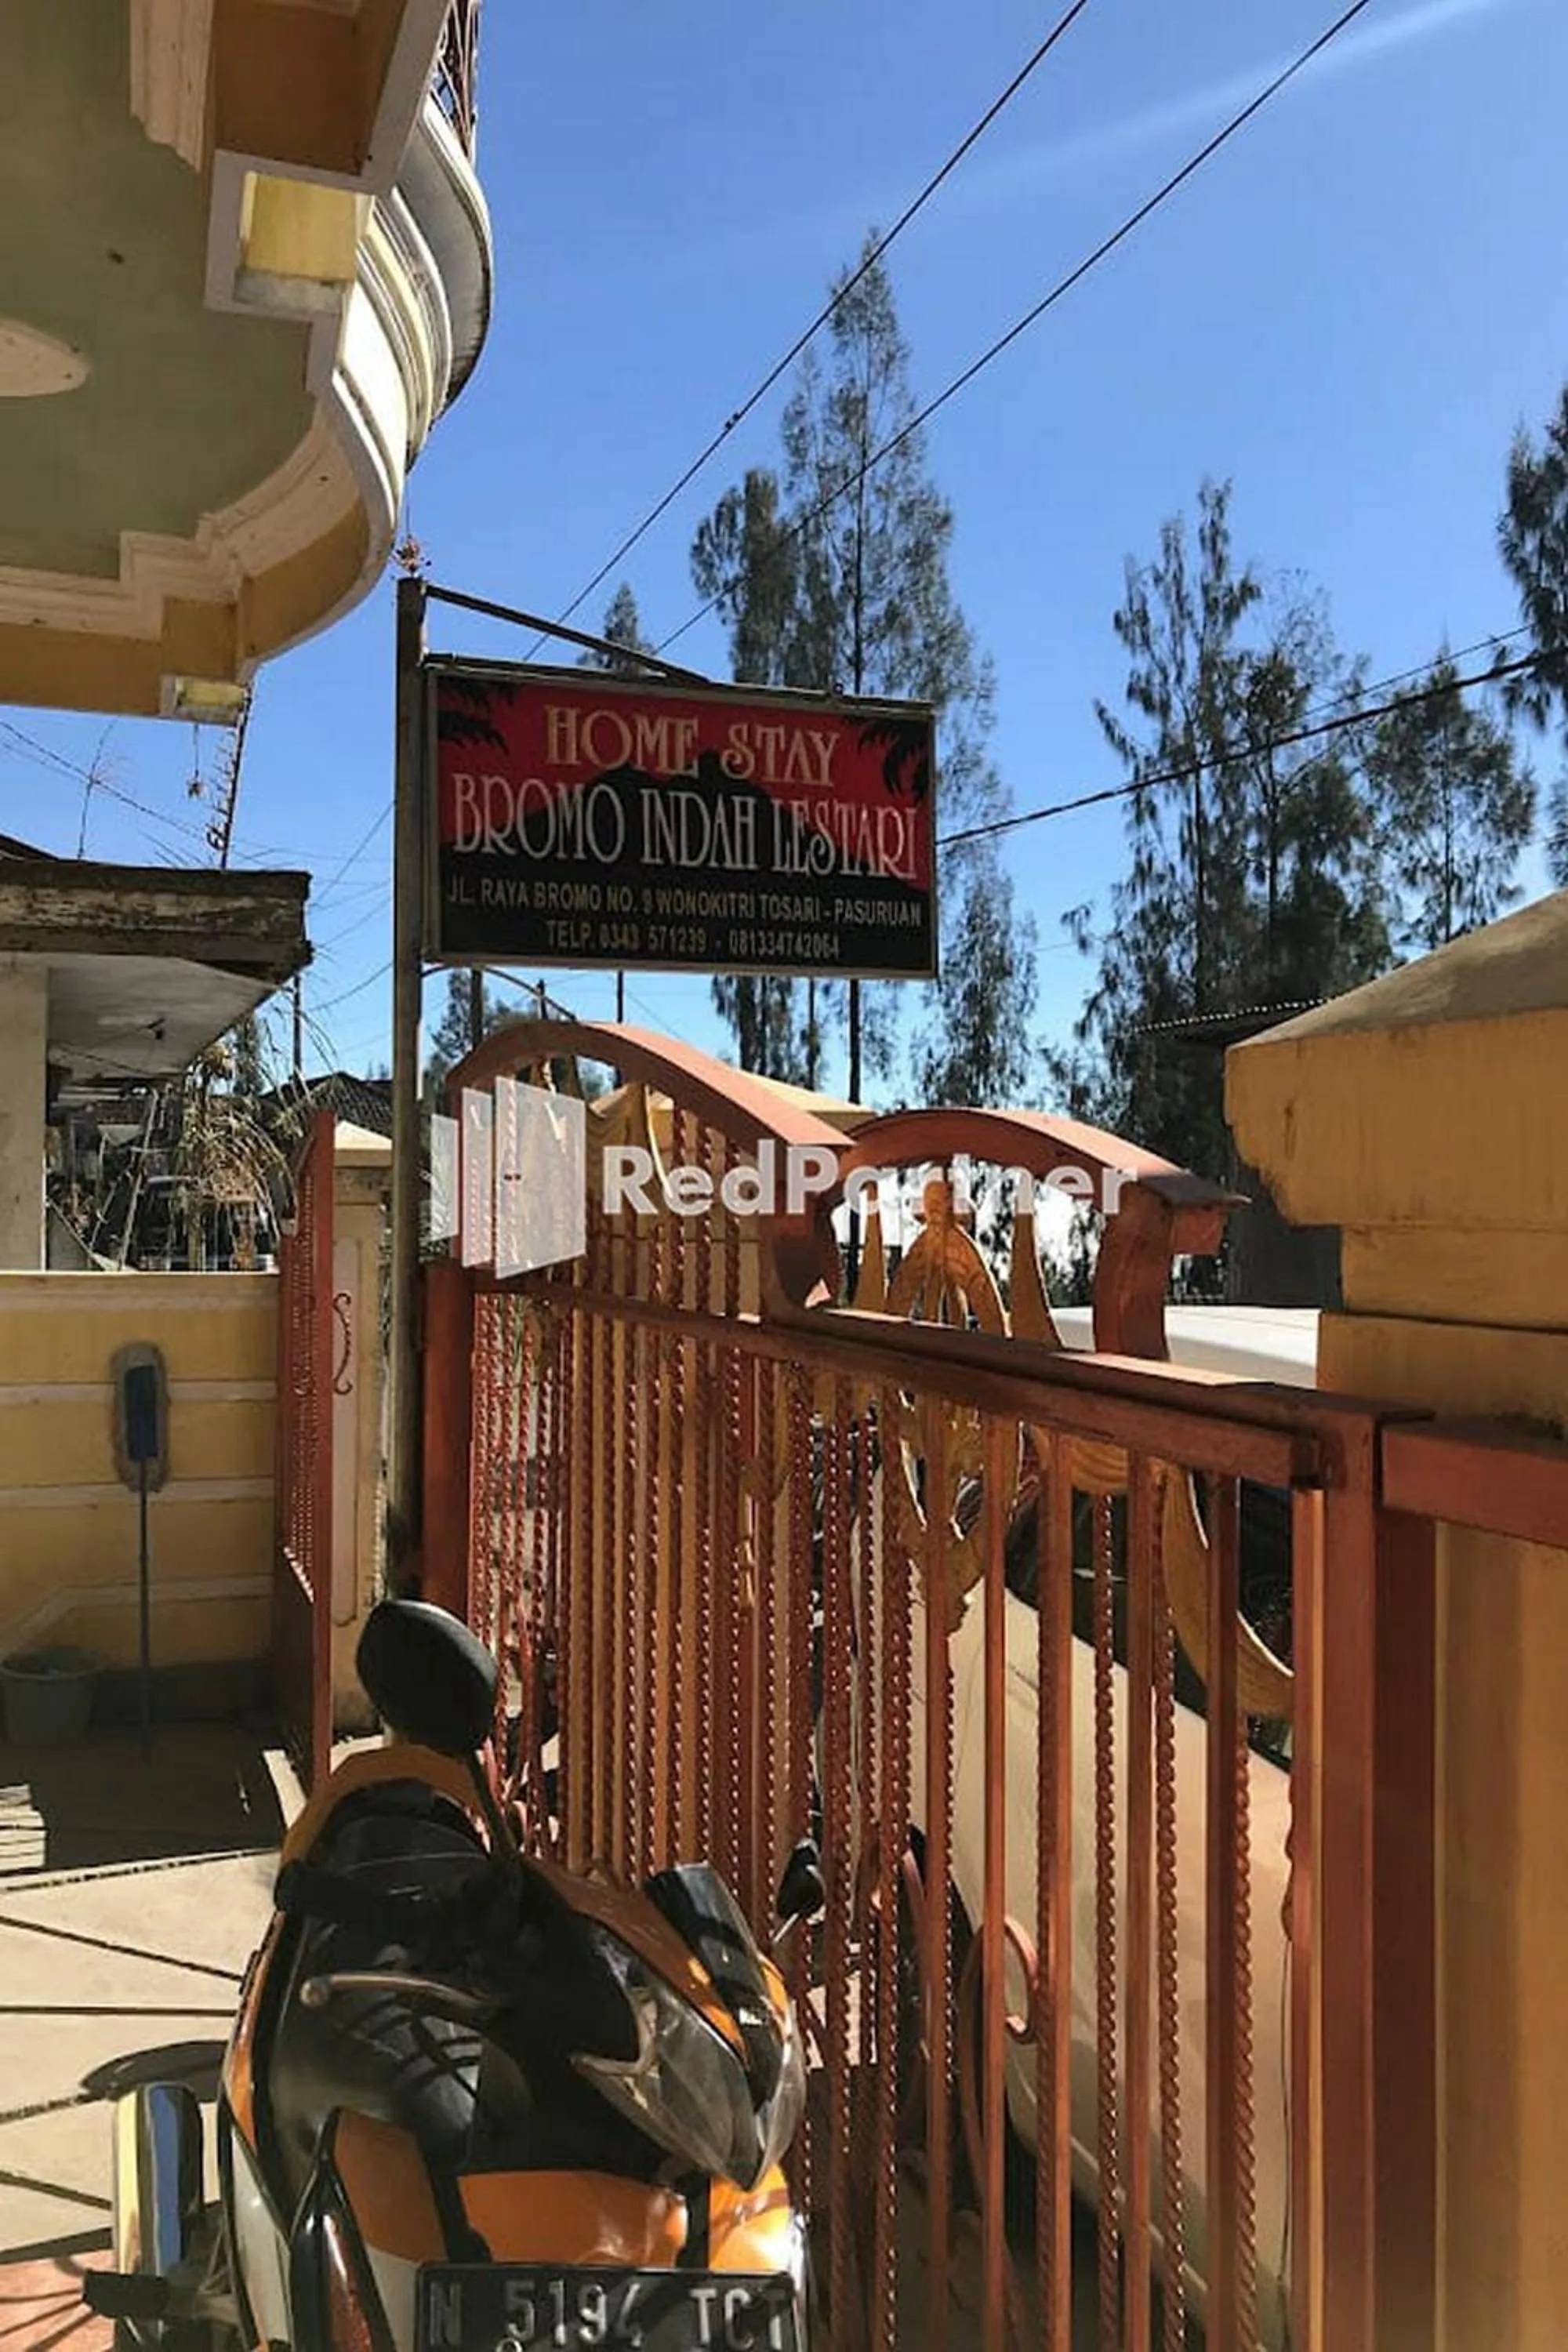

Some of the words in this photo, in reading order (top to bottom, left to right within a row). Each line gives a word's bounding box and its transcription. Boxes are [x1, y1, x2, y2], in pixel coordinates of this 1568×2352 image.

[548, 705, 699, 779] HOME
[720, 723, 840, 786] STAY
[452, 772, 624, 862] BROMO
[641, 788, 756, 870] INDAH
[771, 799, 916, 880] LESTARI
[447, 874, 475, 904] JL.
[480, 877, 530, 909] RAYA
[533, 881, 602, 912] BROMO
[606, 885, 638, 913] NO.
[655, 887, 755, 919] WONOKITRI
[760, 892, 820, 922] TOSARI
[834, 898, 922, 927] PASURUAN
[546, 920, 595, 951] TELP.
[430, 2279, 462, 2347] N
[503, 2279, 643, 2349] 5194
